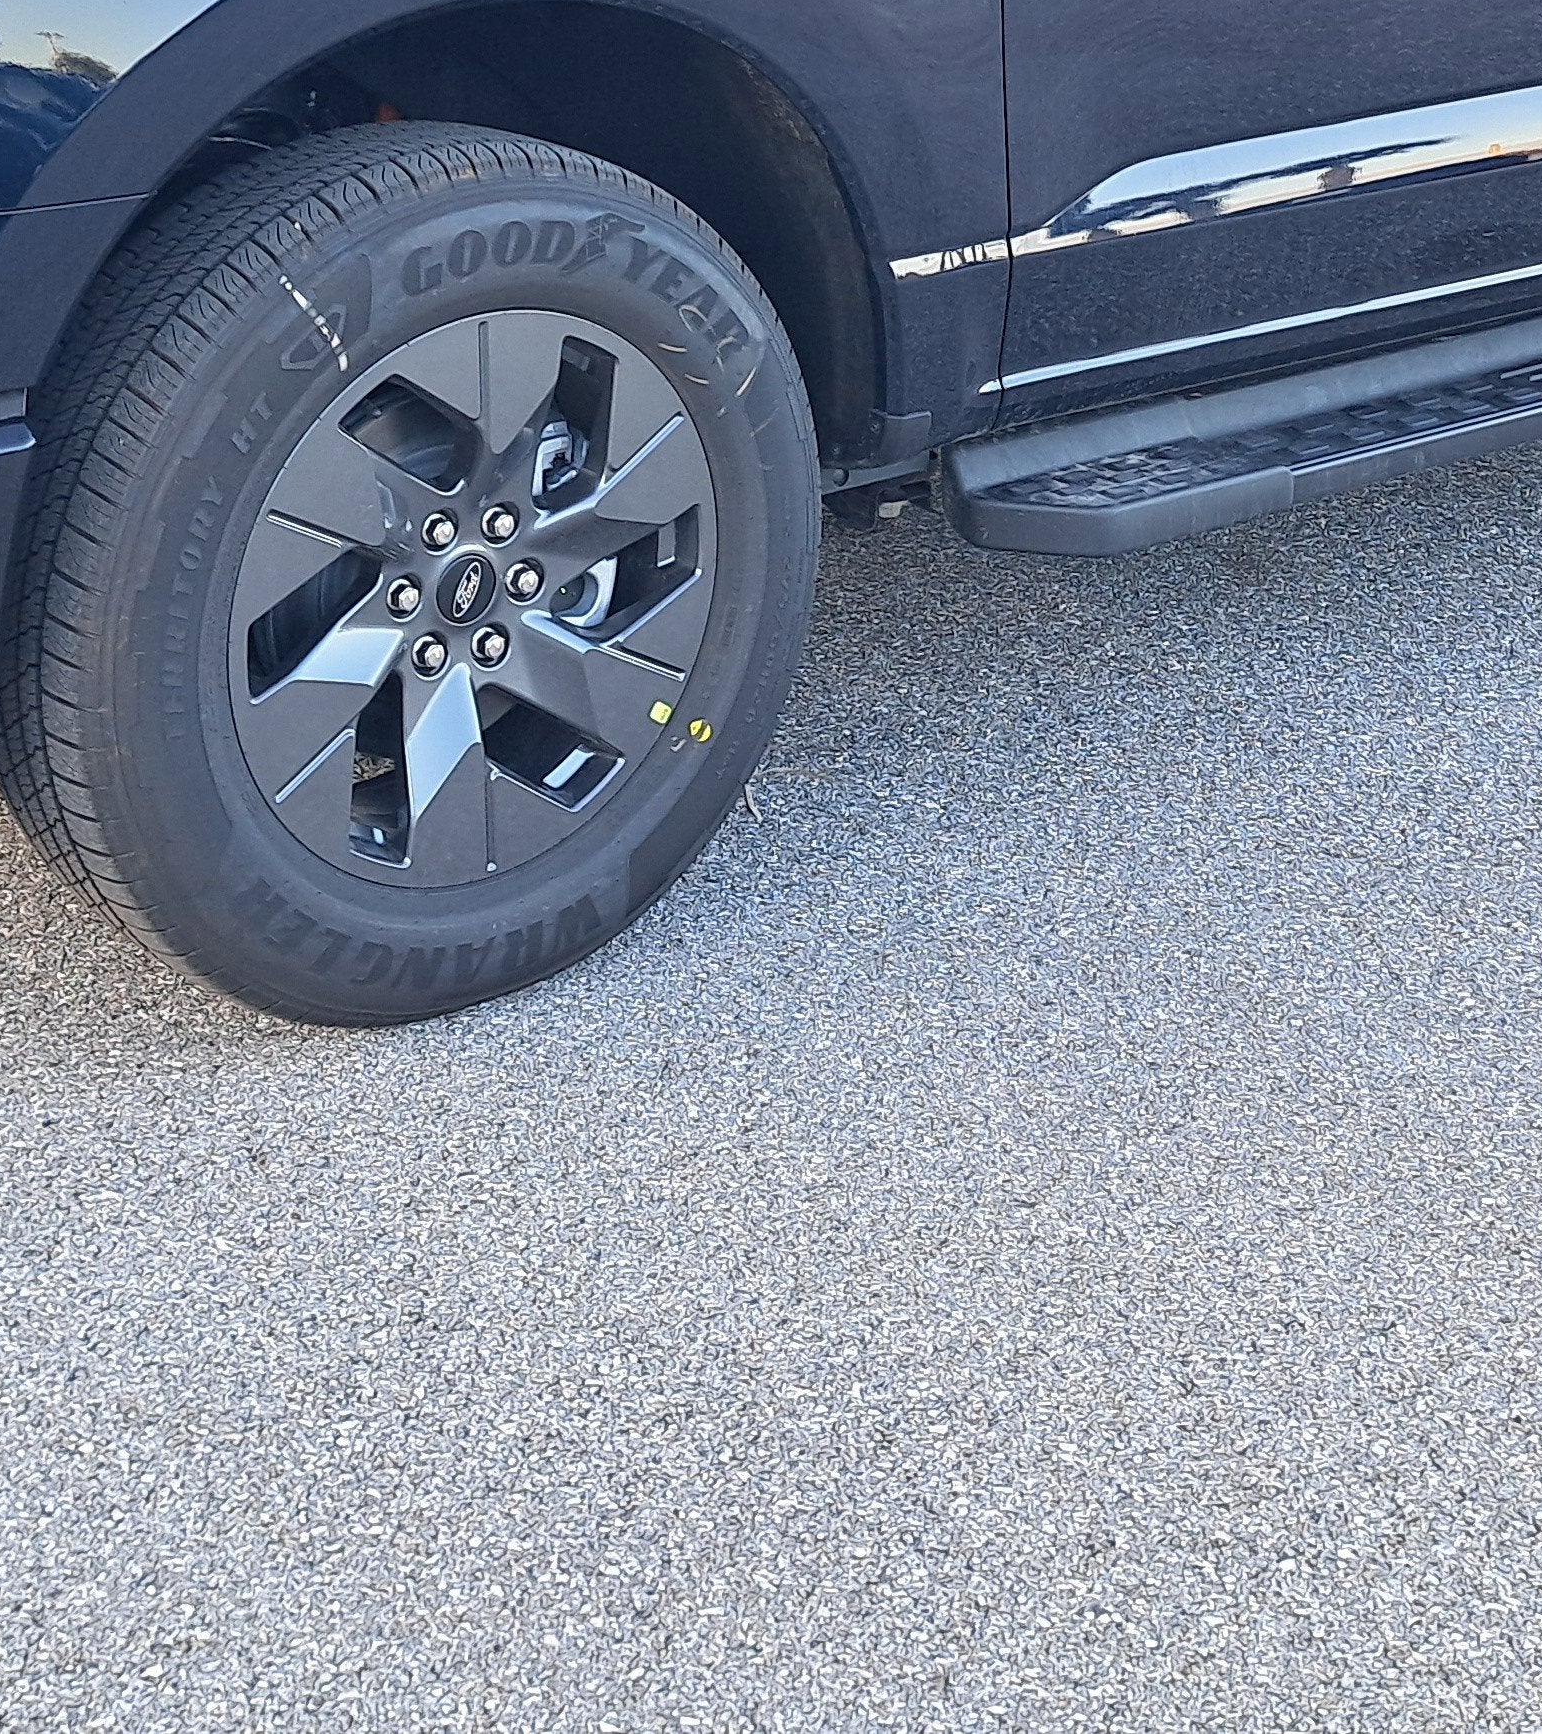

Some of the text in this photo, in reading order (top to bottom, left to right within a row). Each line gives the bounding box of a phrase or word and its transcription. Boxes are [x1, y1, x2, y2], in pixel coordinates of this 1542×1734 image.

[401, 212, 750, 354] GOODYEAR
[455, 565, 480, 612] Ford
[228, 876, 602, 991] WRANGLER
